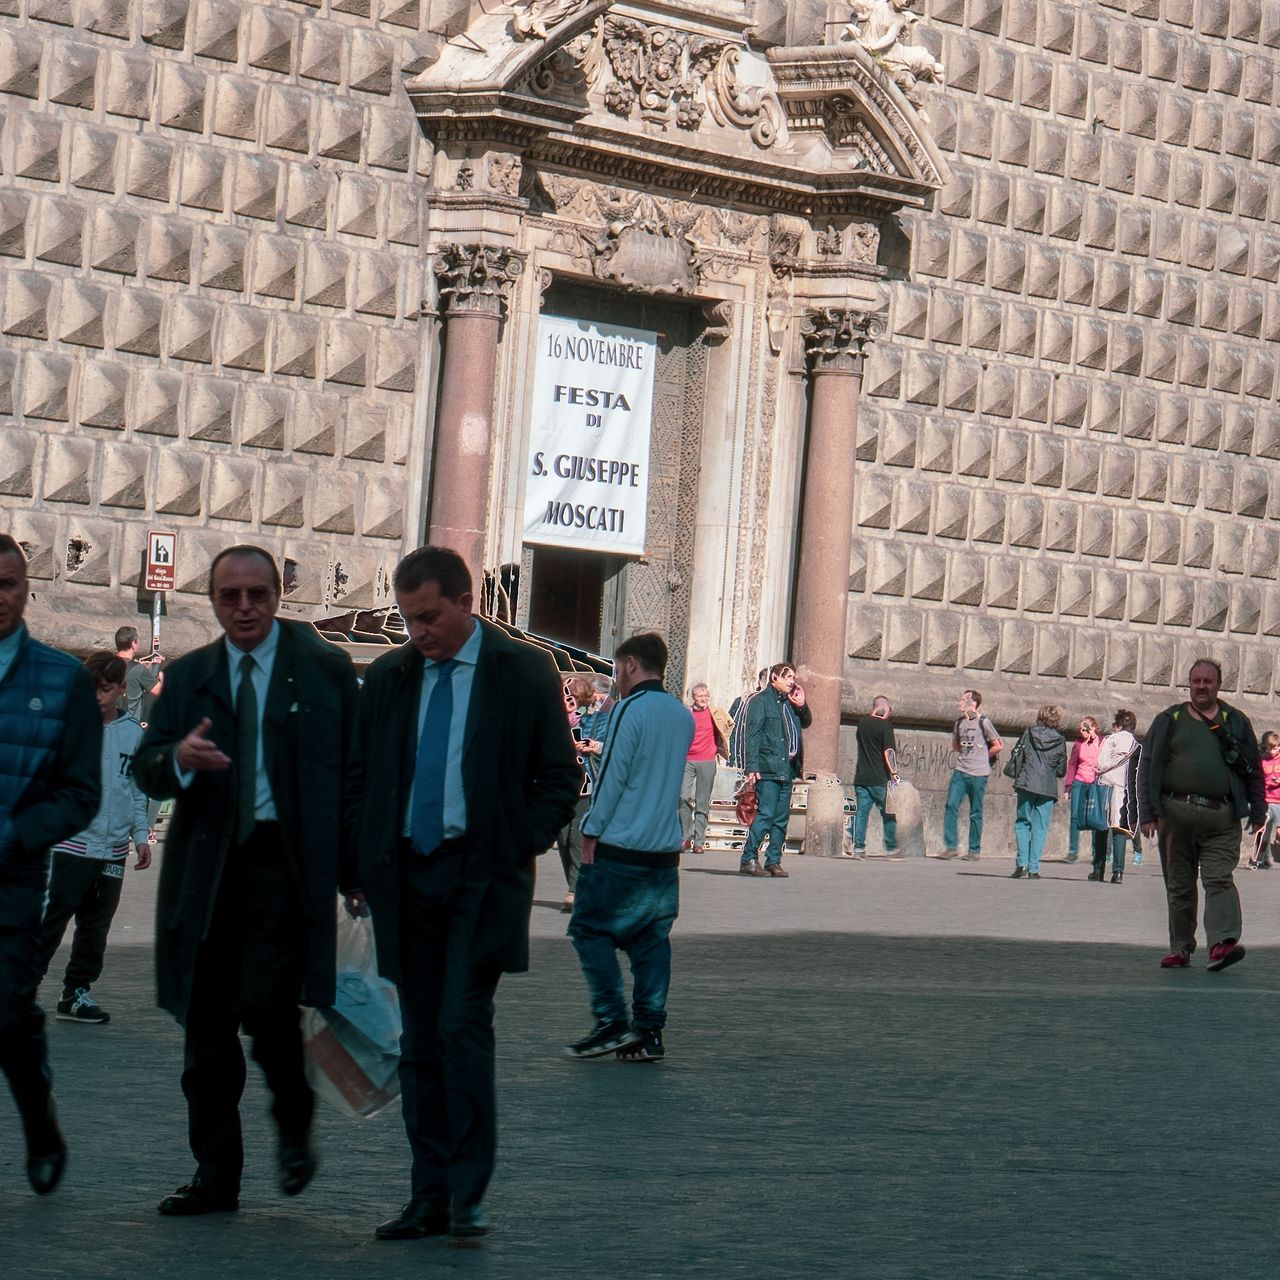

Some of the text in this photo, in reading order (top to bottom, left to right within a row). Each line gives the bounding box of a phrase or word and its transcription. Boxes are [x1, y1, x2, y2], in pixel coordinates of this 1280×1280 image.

[547, 333, 643, 370] 16 NOVEMBRE
[553, 384, 631, 411] FESTA
[585, 413, 602, 428] DI
[532, 452, 639, 488] S. GIUSEPPE
[542, 500, 625, 533] MOSCATI
